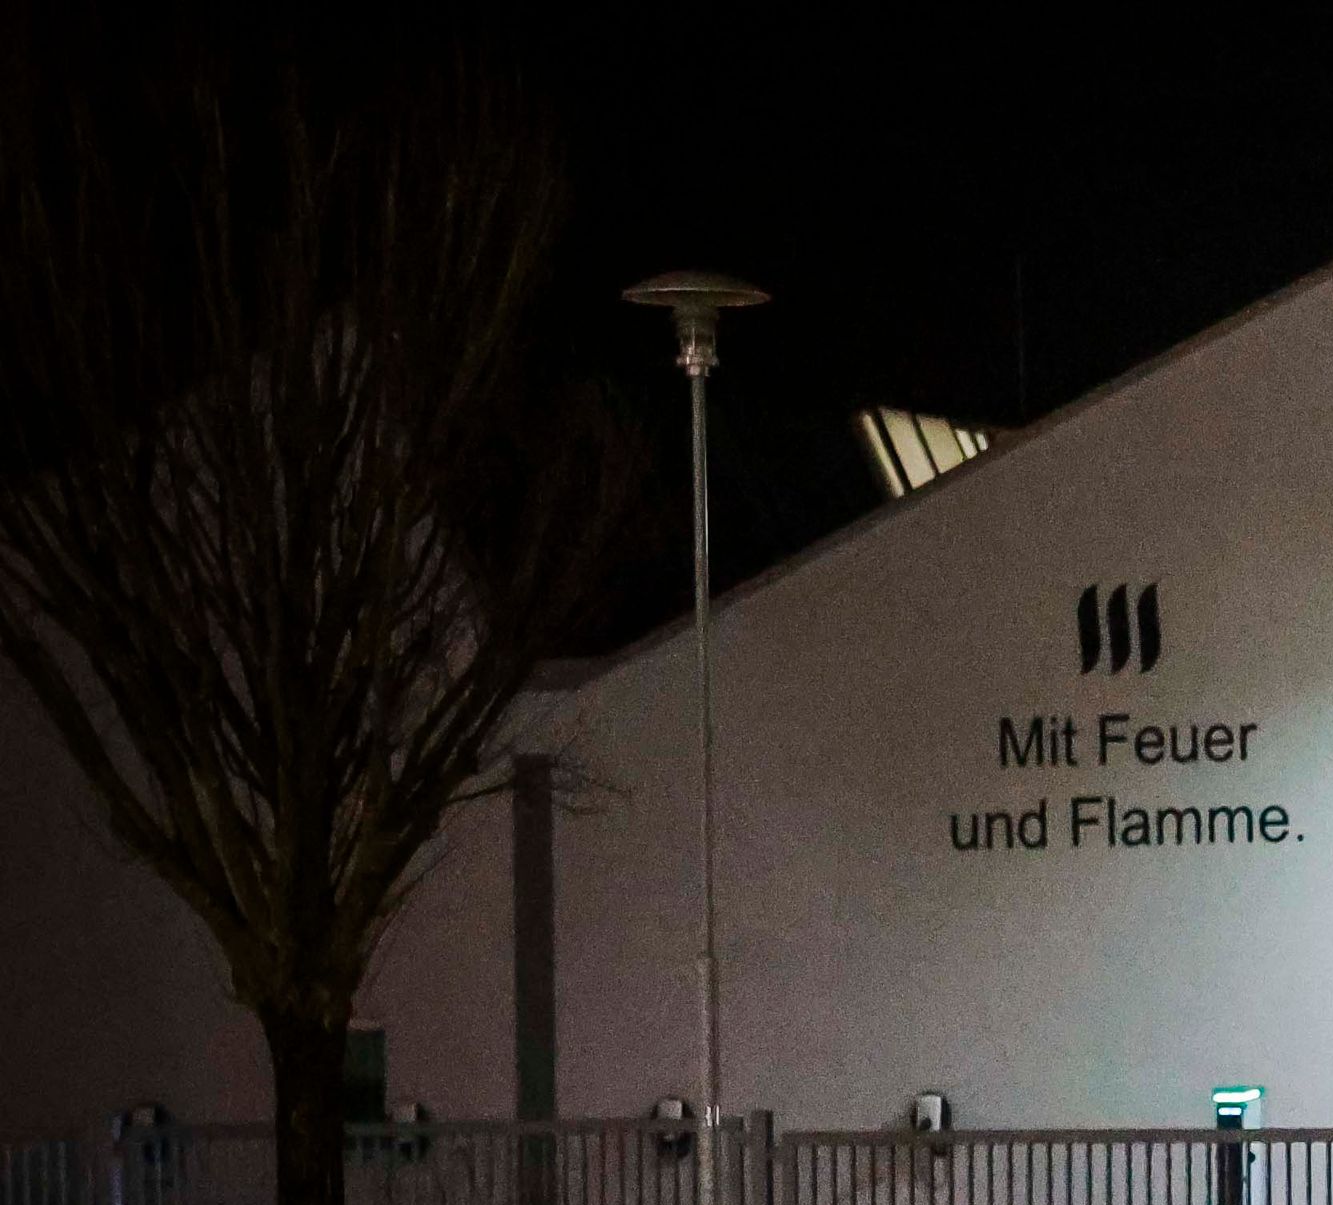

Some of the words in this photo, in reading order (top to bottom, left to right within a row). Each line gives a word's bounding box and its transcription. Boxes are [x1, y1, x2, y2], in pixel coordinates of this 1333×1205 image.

[1000, 715, 1078, 767] Mit
[1099, 713, 1258, 764] Feuer
[949, 800, 1047, 850] und
[1069, 796, 1305, 848] Flamme.
